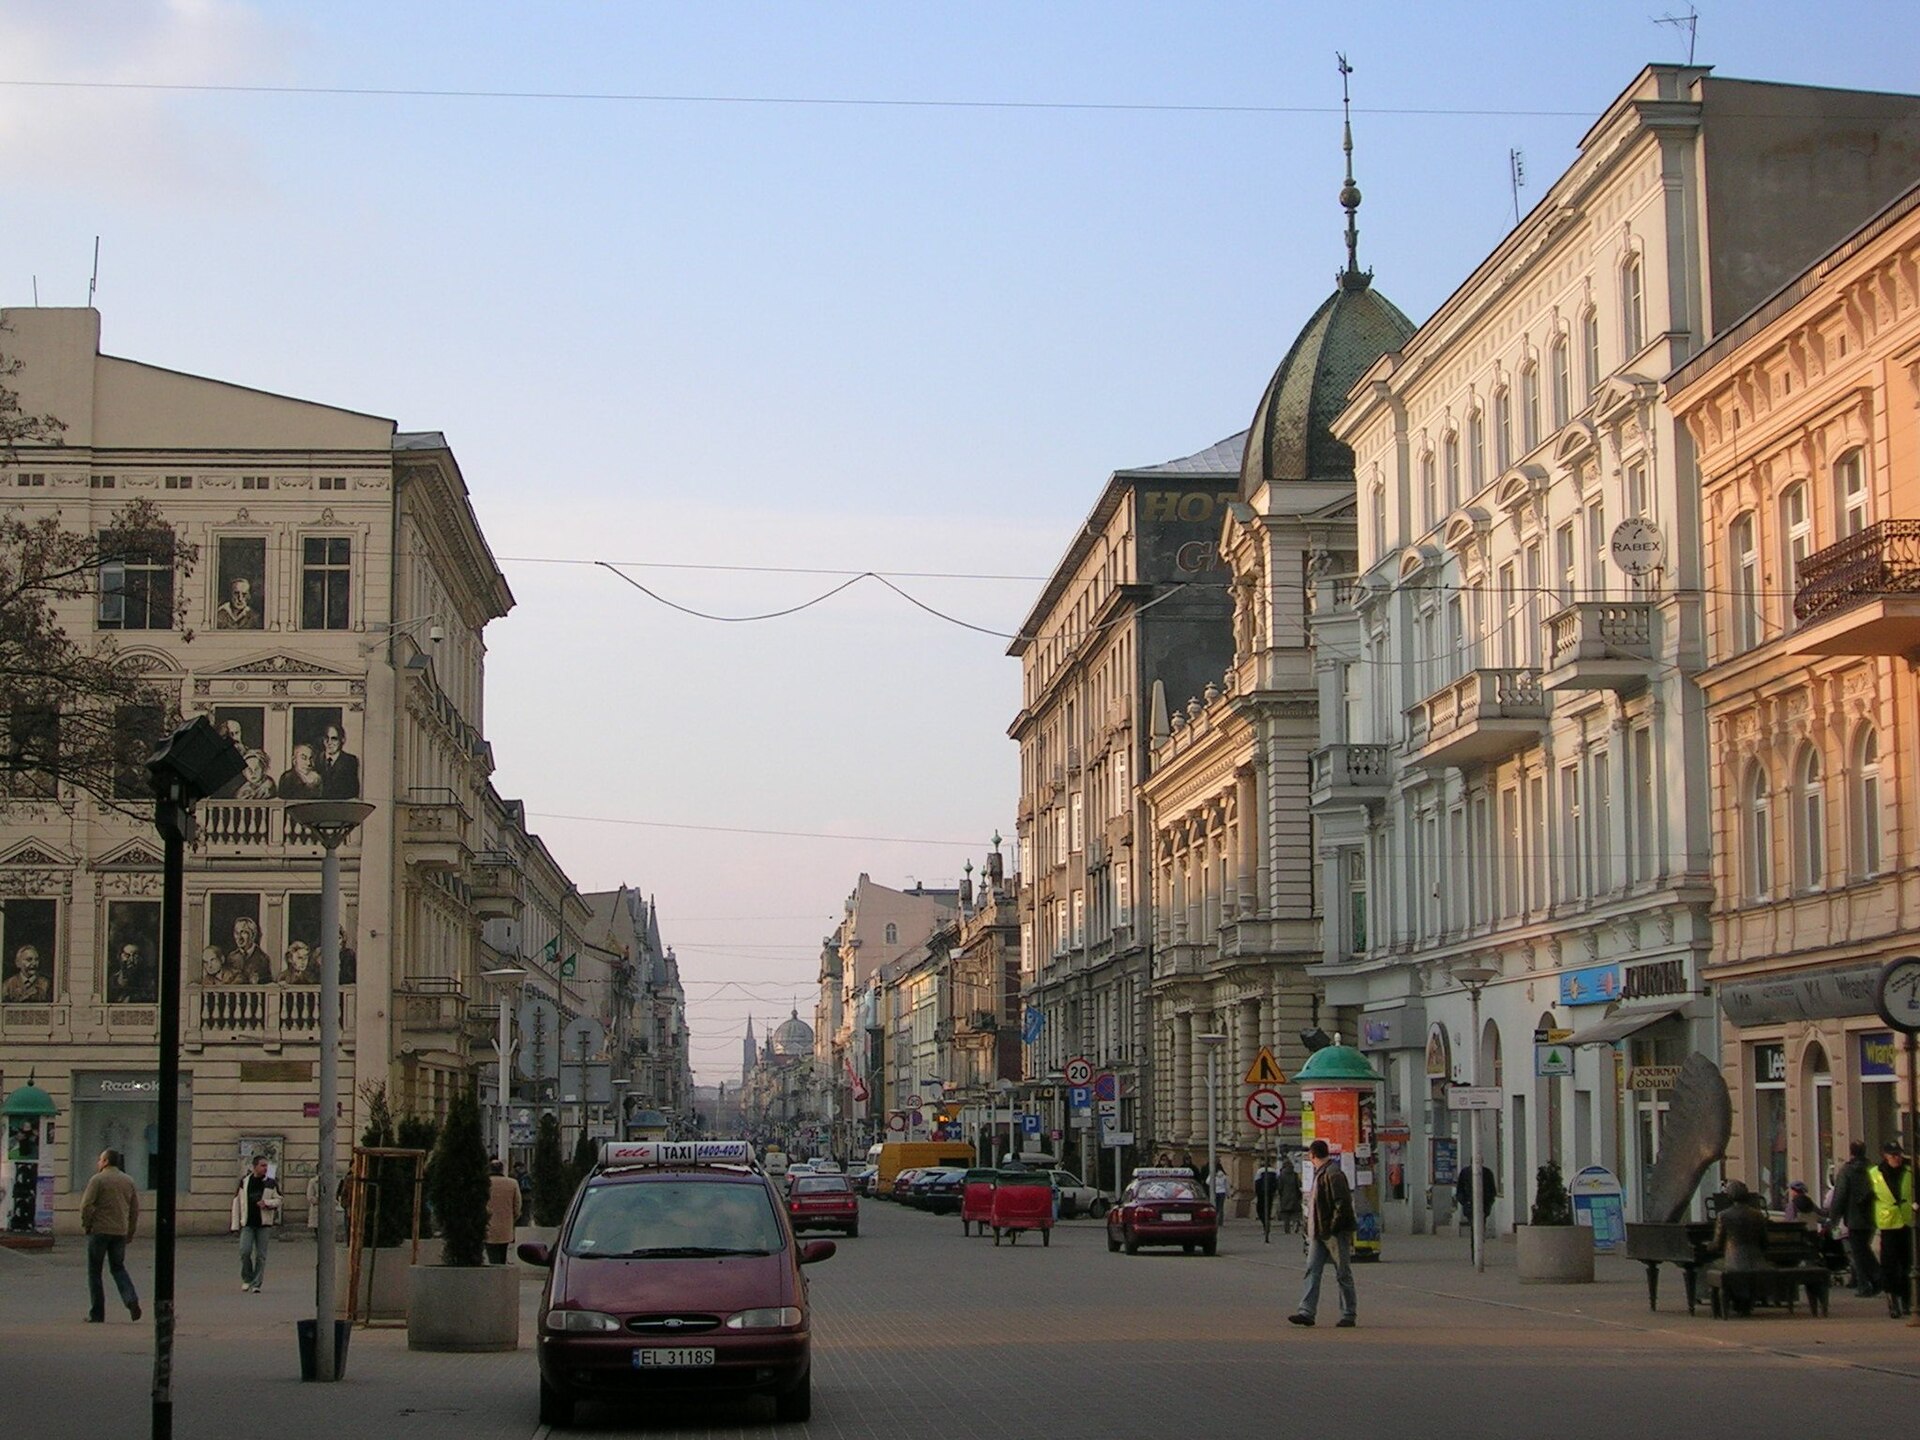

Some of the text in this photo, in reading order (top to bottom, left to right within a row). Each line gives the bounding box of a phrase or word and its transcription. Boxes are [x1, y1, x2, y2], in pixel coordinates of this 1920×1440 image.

[1613, 541, 1660, 553] RABEX
[1622, 960, 1687, 999] JOURNAL
[1070, 1066, 1088, 1079] 20
[101, 1079, 160, 1092] Reebok
[1073, 1089, 1087, 1105] P
[614, 1147, 651, 1158] tele
[662, 1146, 692, 1160] TAXI
[641, 1350, 713, 1365] EL 3118S
